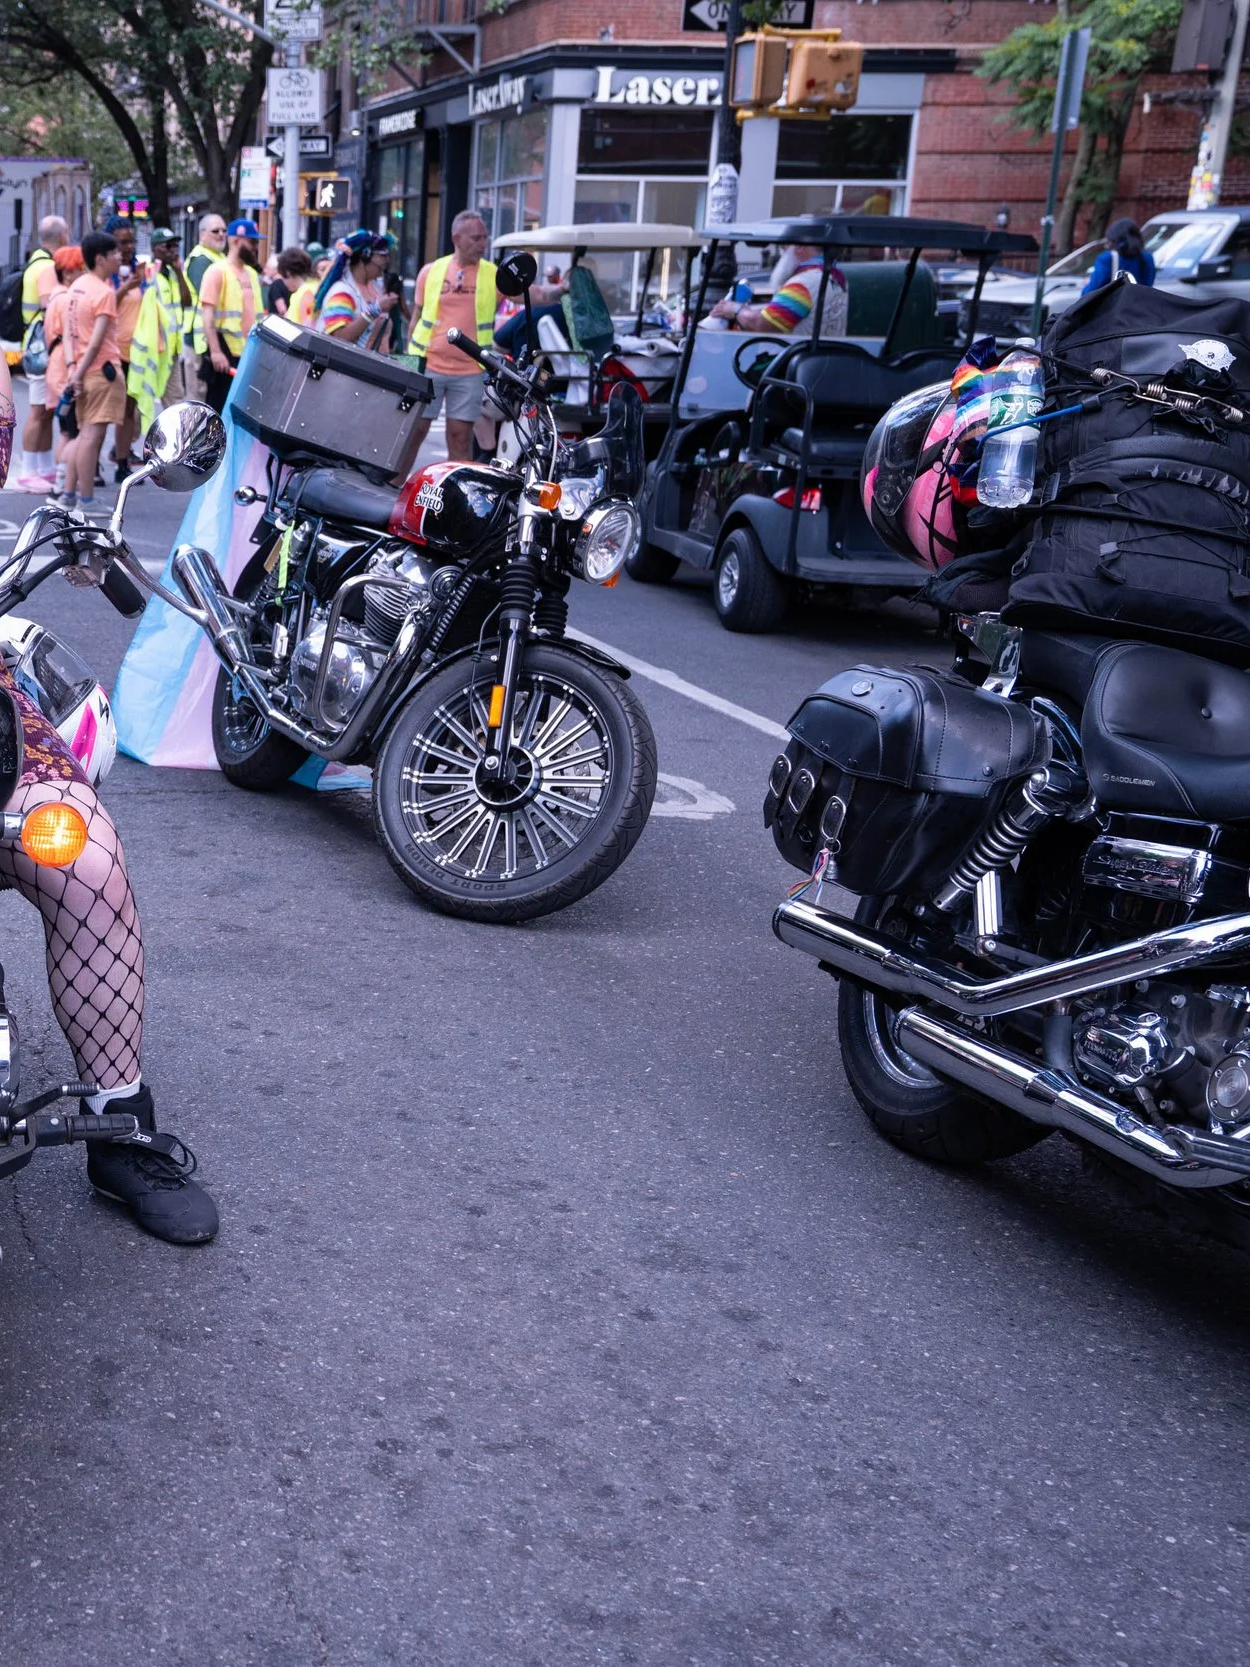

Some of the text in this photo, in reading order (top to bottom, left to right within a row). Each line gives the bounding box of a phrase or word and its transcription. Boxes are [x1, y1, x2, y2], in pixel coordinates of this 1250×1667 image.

[276, 89, 312, 97] ALLOWED
[468, 75, 527, 116] LaserAway
[279, 101, 308, 109] USE OF
[271, 112, 316, 120] FULL LANE
[422, 481, 444, 499] ROYAL
[414, 494, 444, 513] ENFIELD
[1110, 775, 1156, 787] SADDLEMEN
[404, 843, 508, 892] SPORT DEMON
